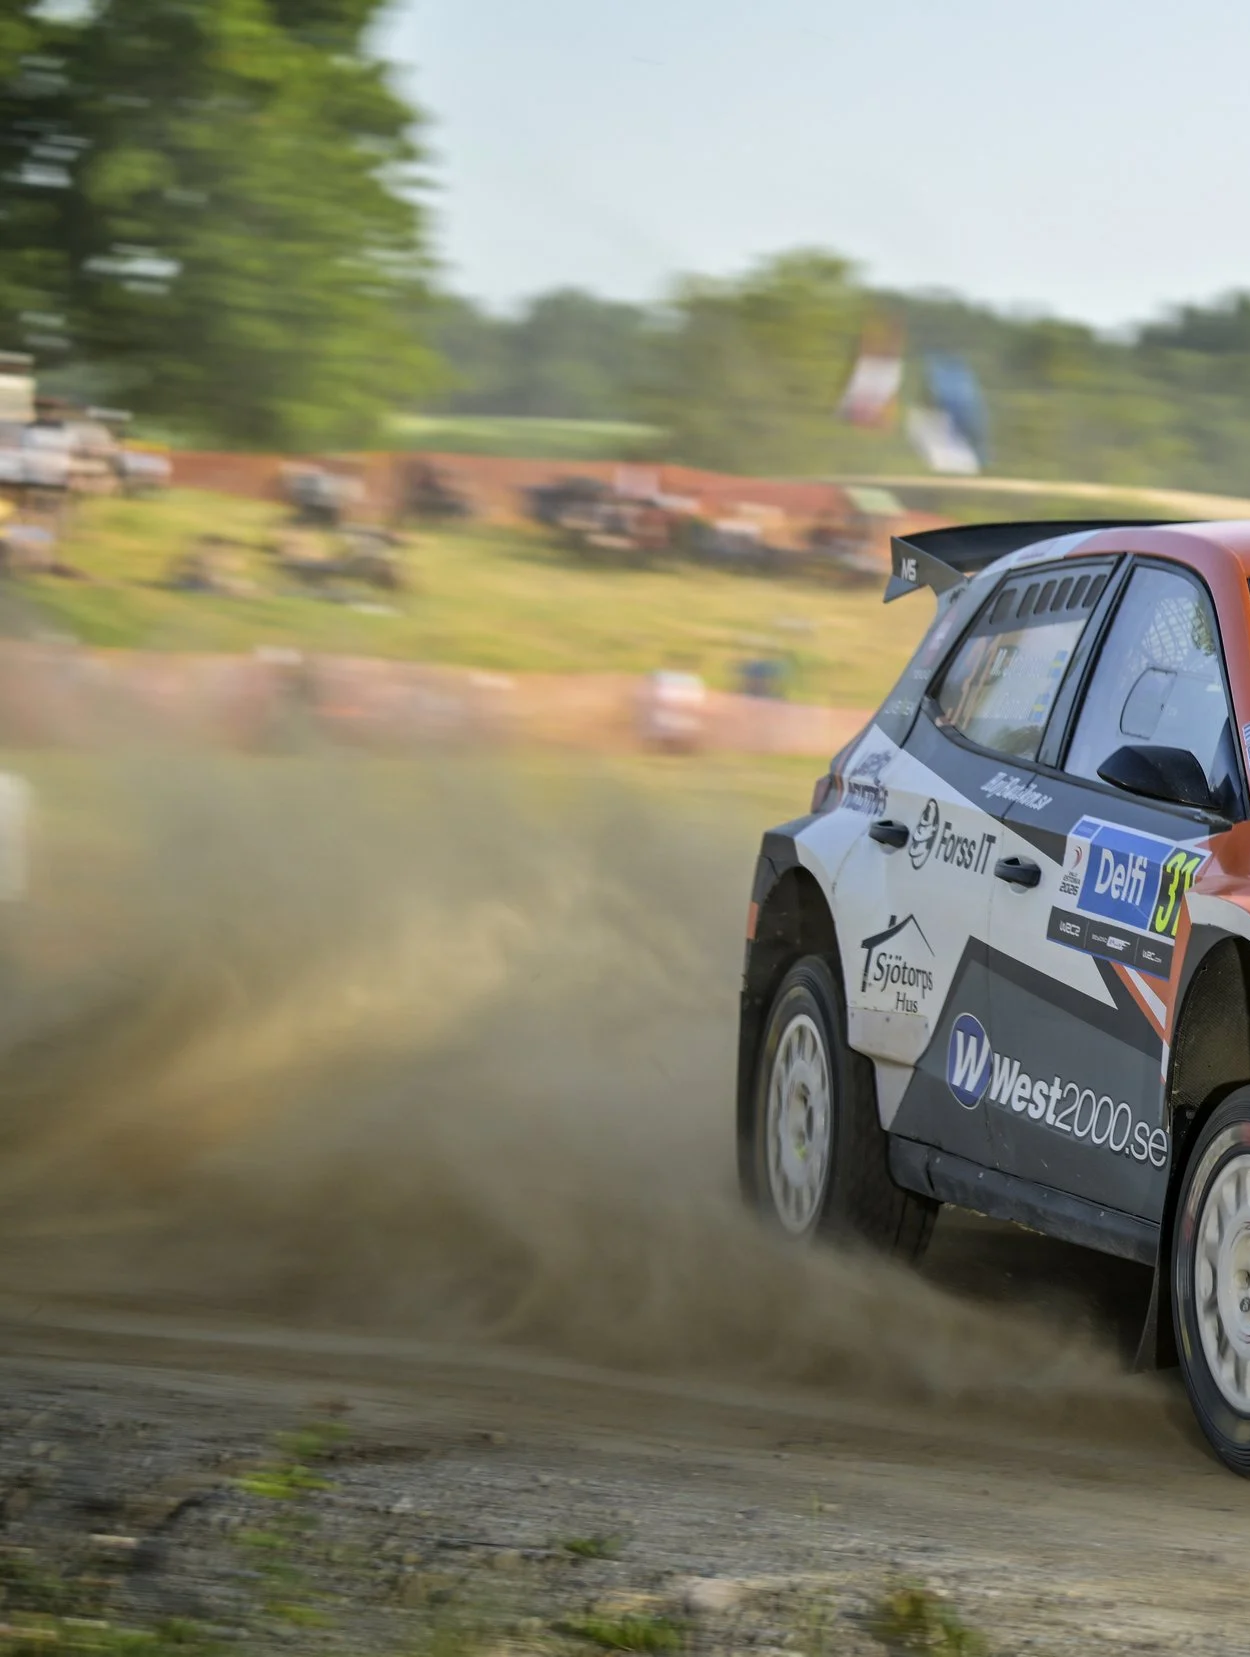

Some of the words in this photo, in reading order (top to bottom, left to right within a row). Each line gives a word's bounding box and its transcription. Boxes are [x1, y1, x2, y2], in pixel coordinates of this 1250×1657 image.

[902, 558, 917, 580] MS
[936, 821, 976, 870] Forss
[974, 832, 997, 875] IT
[1094, 847, 1148, 906] Delfi
[1155, 851, 1200, 936] 31
[873, 952, 933, 998] Sjötorps
[895, 992, 918, 1013] Hus
[989, 1052, 1168, 1167] West2000.se
